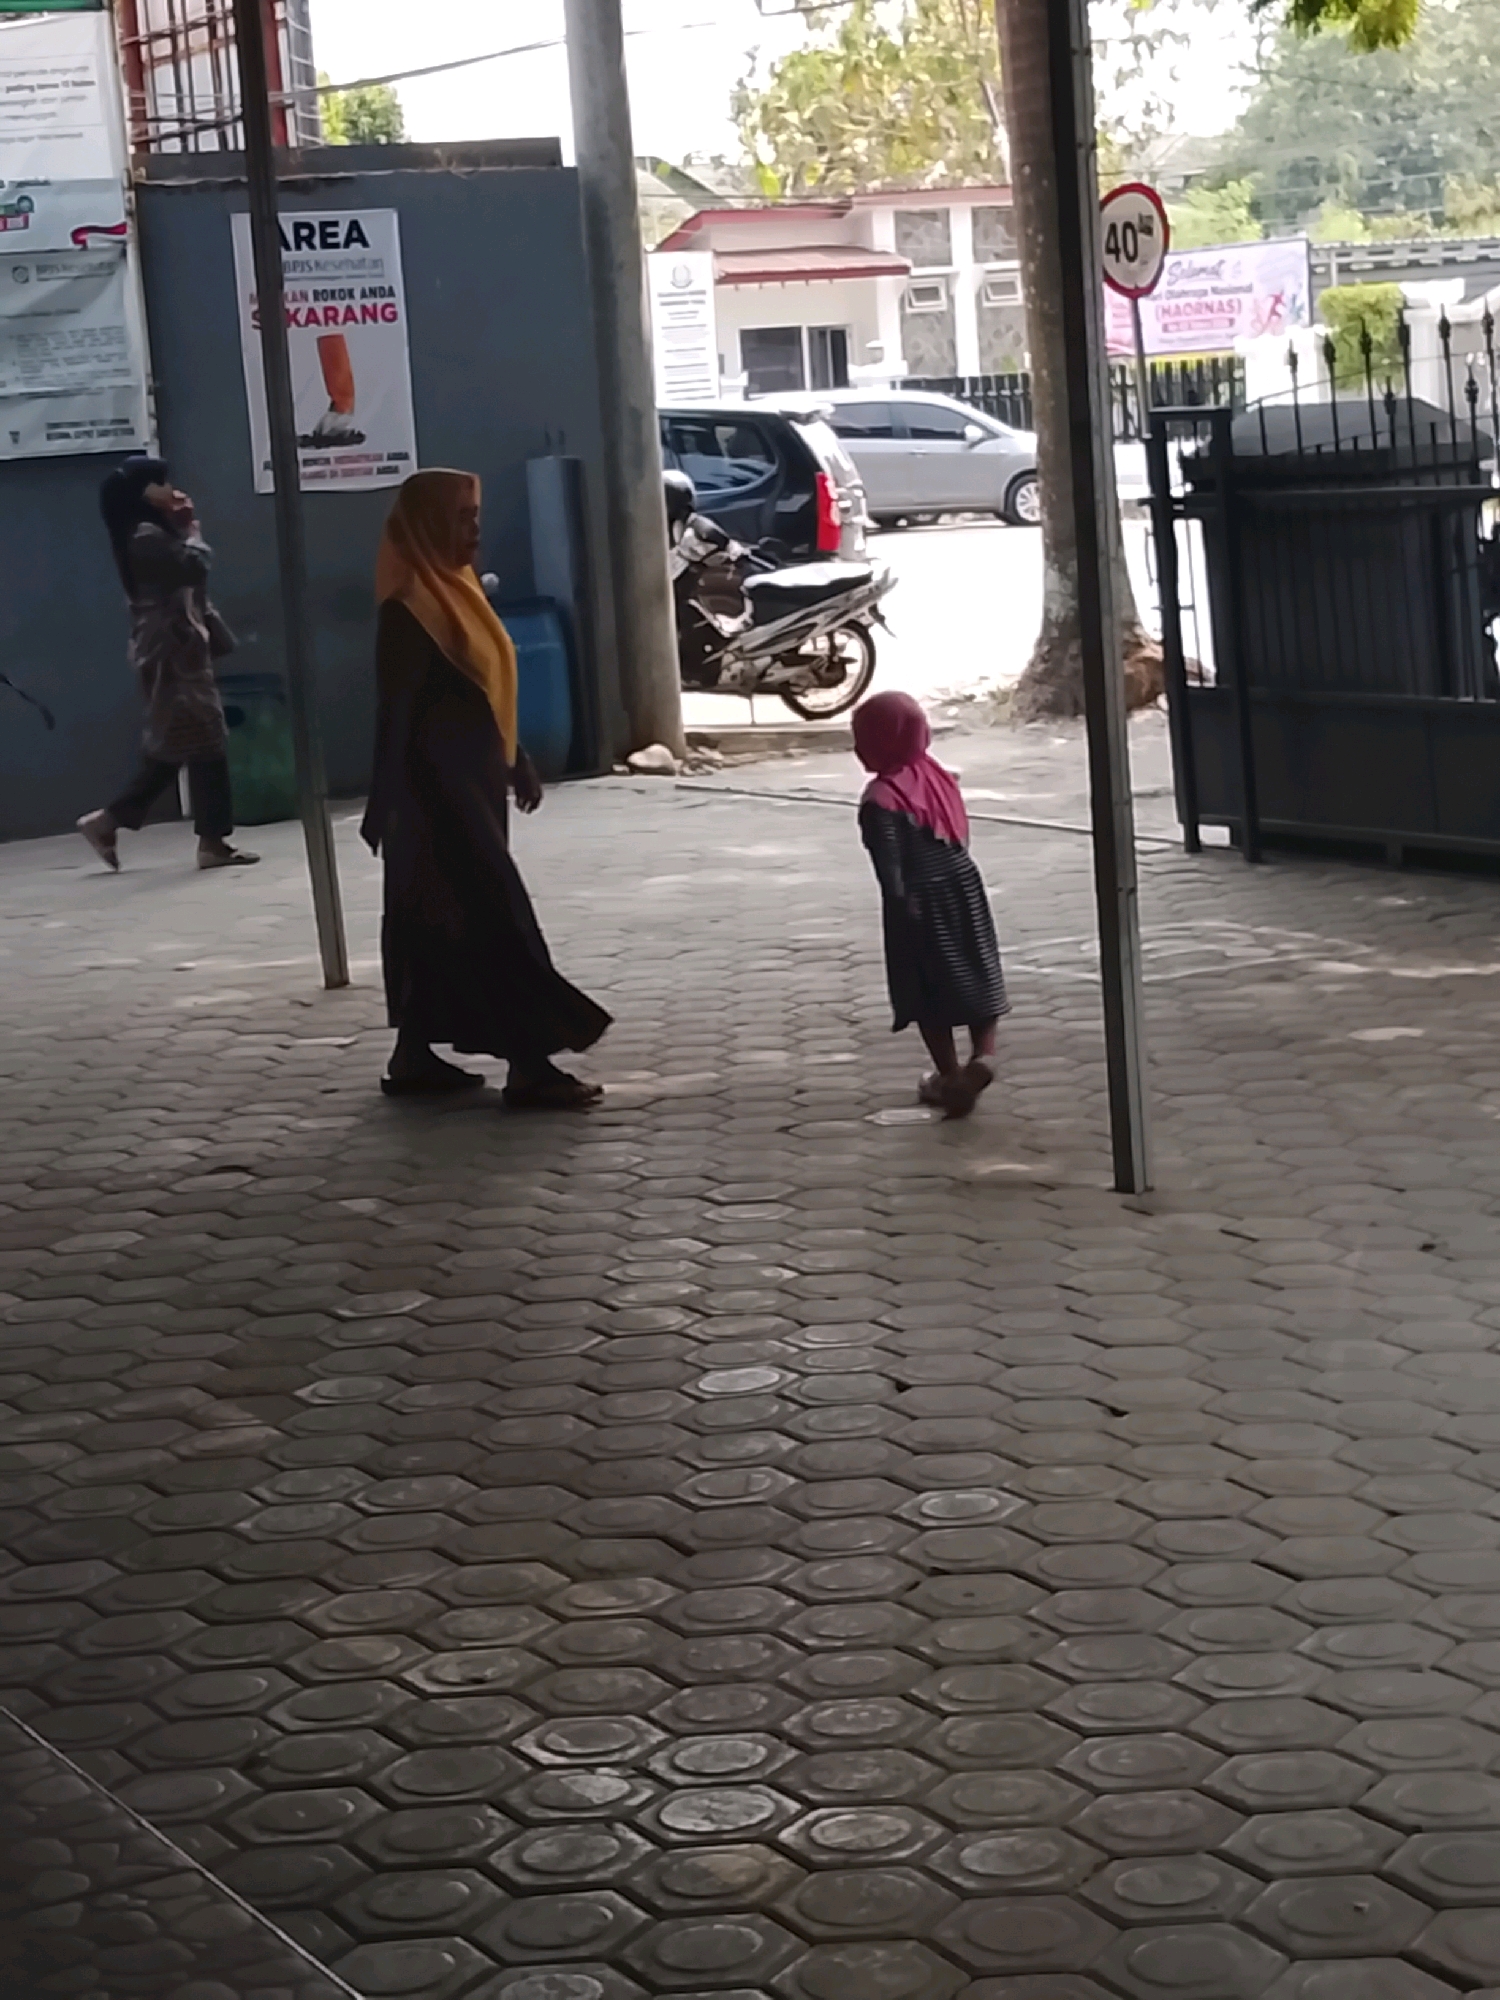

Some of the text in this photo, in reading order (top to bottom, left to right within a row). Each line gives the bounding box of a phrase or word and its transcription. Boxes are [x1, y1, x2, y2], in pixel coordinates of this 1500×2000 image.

[1105, 221, 1138, 263] 40
[313, 288, 355, 302] ROKOK
[360, 285, 396, 299] ANDA
[251, 302, 399, 330] SKARANG
[1156, 298, 1241, 321] (HAORNAS)
